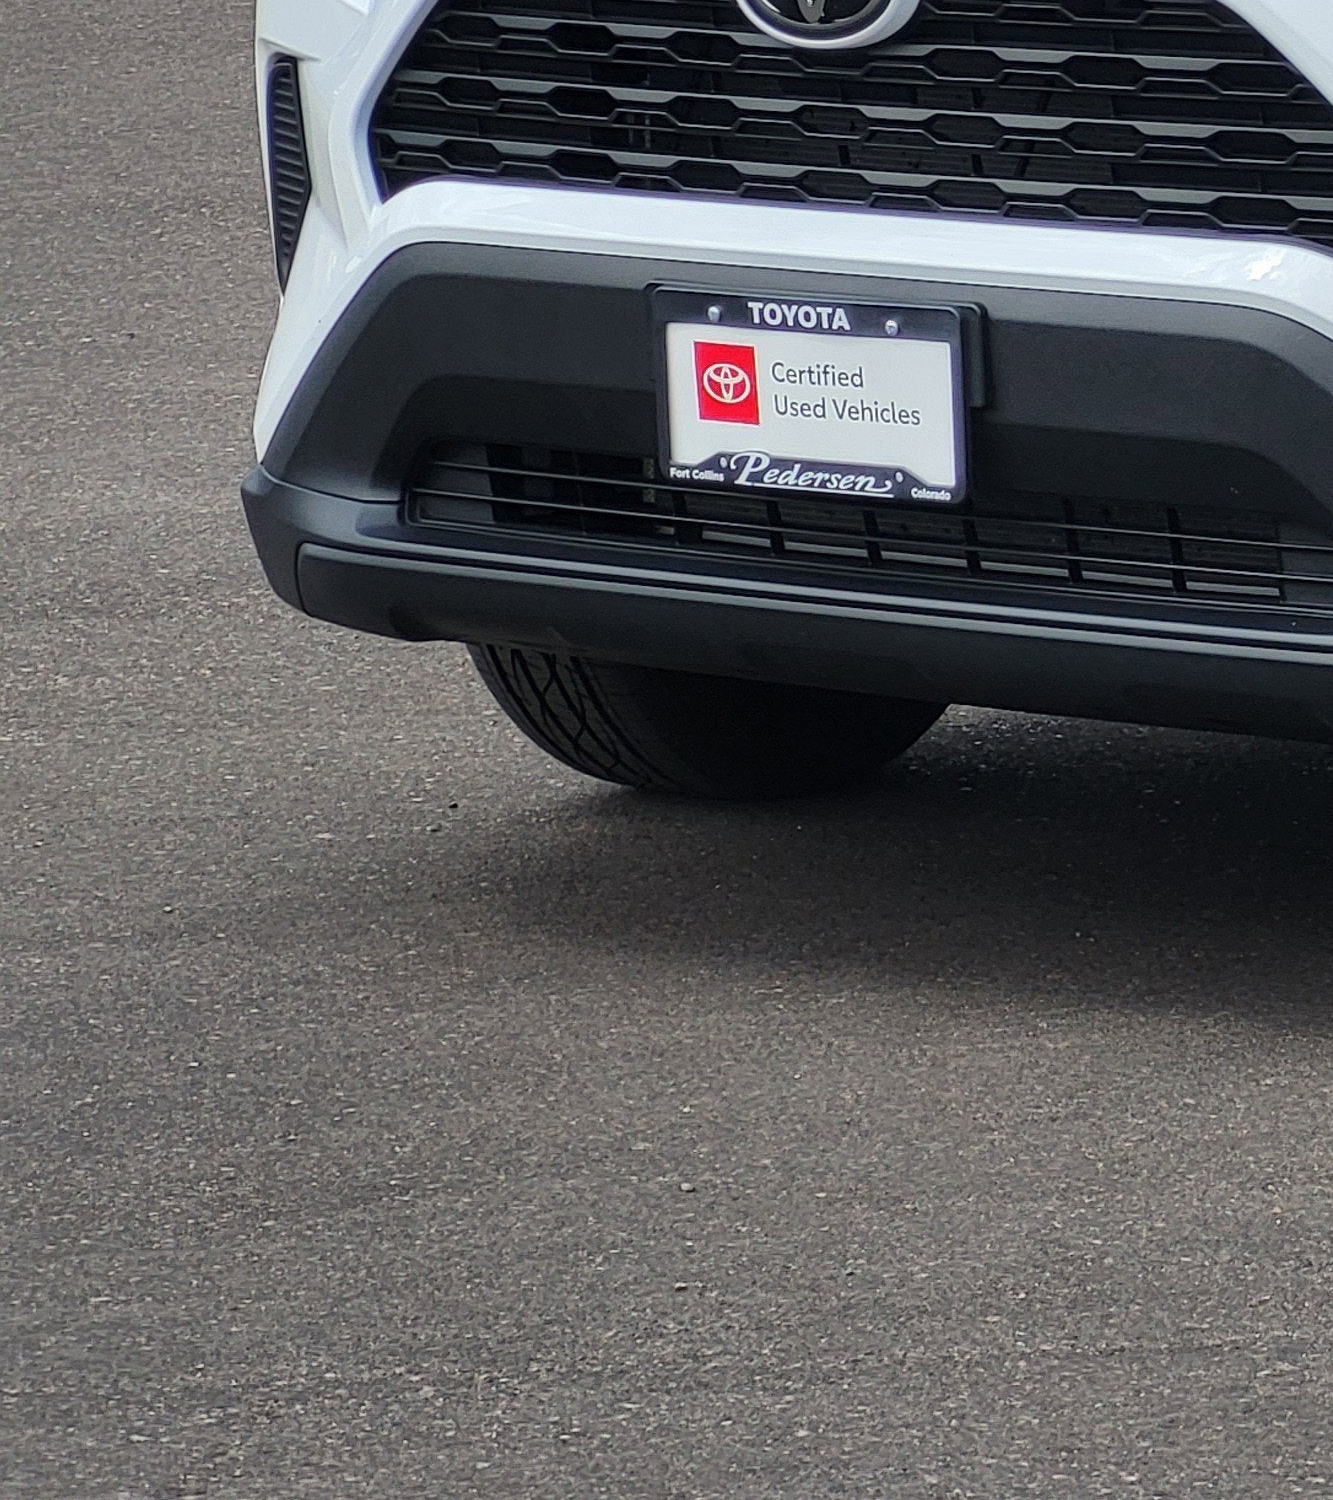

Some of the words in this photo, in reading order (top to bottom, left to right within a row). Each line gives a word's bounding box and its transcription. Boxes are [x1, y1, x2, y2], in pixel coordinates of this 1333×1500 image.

[747, 301, 851, 331] TOYOTA
[771, 362, 864, 388] Certified
[774, 394, 826, 419] Used
[832, 398, 921, 426] Vehicles
[669, 466, 691, 480] Fort
[692, 468, 725, 483] Collins
[729, 450, 893, 493] Pedersen
[910, 486, 952, 501] Colorado
